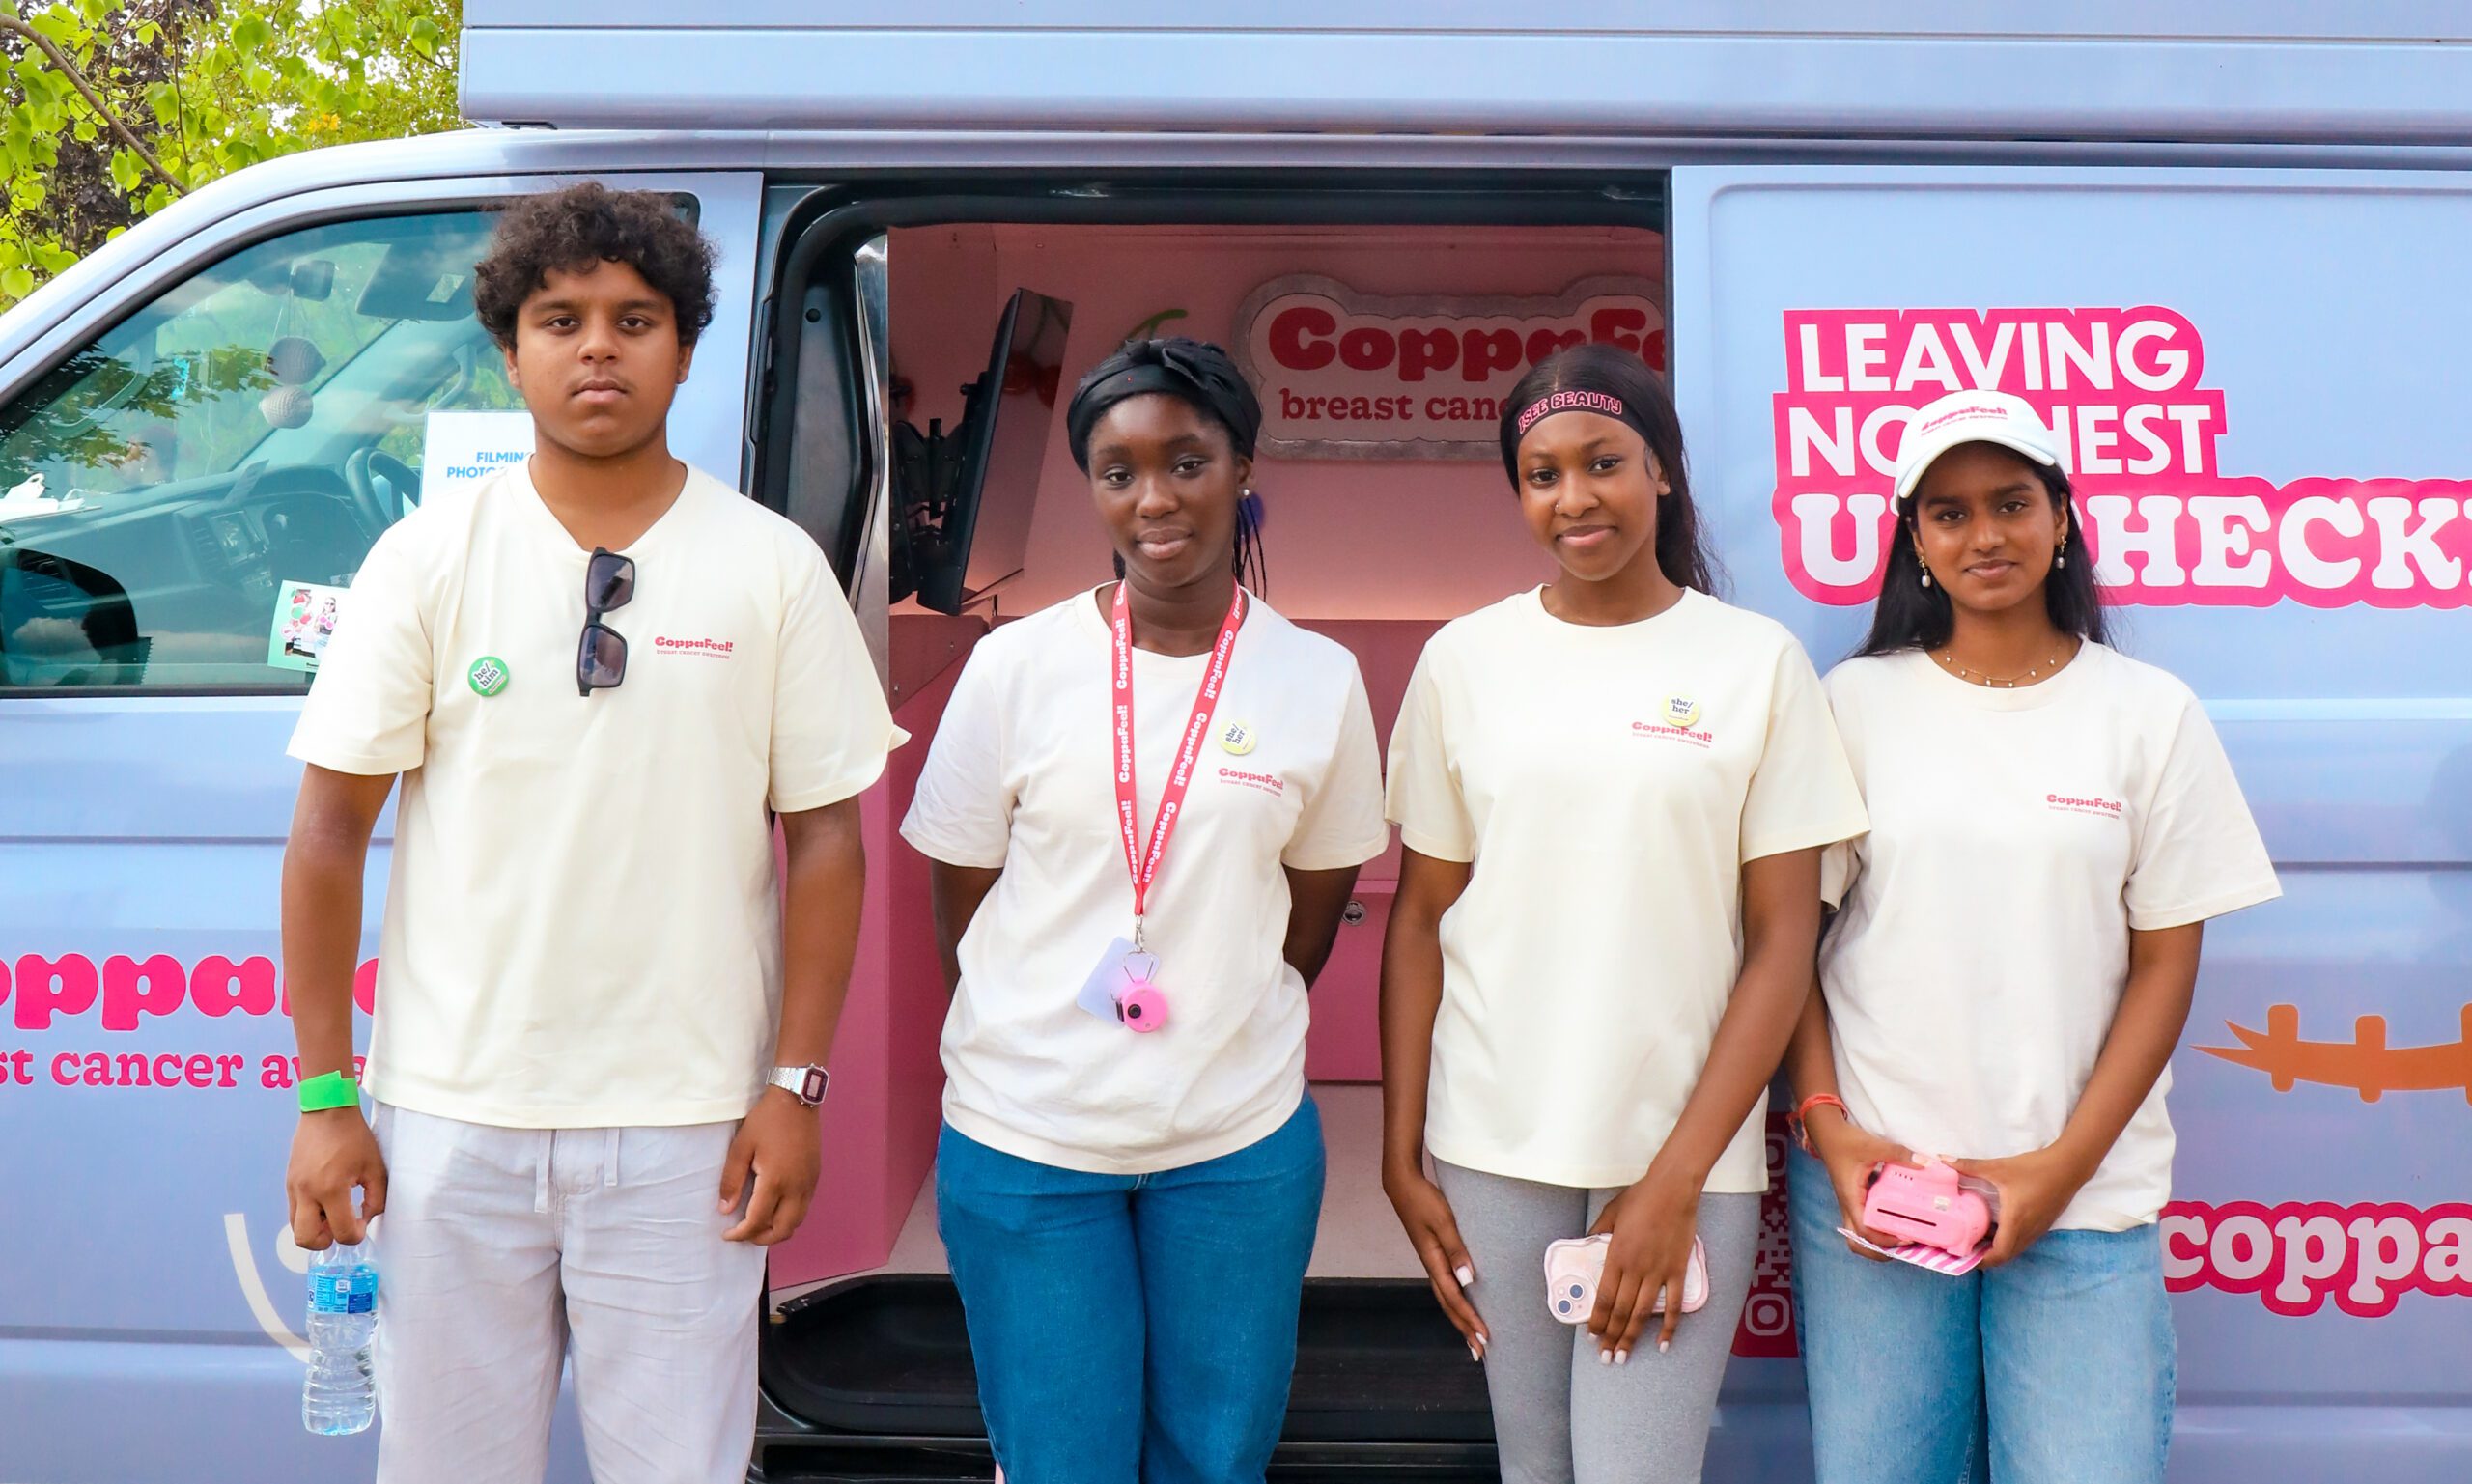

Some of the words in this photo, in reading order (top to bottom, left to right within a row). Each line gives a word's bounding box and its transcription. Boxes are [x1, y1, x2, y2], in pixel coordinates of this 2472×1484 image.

[1799, 319, 2190, 392] LEAVING
[1279, 388, 1414, 420] breast
[1551, 391, 1622, 415] BEAUTY
[654, 636, 734, 653] CoppaFeel!
[1116, 618, 1129, 690] CoppaFeel!
[473, 662, 491, 681] he/
[479, 668, 499, 687] him
[1204, 630, 1234, 699] CoppaFeel!
[1671, 698, 1695, 709] she/
[1671, 705, 1690, 714] her
[1117, 705, 1131, 783] CoppaFeel!
[1174, 712, 1208, 787] CoppaFeel!
[1141, 801, 1178, 883] CoppaFeel!
[51, 1051, 244, 1088] cancer
